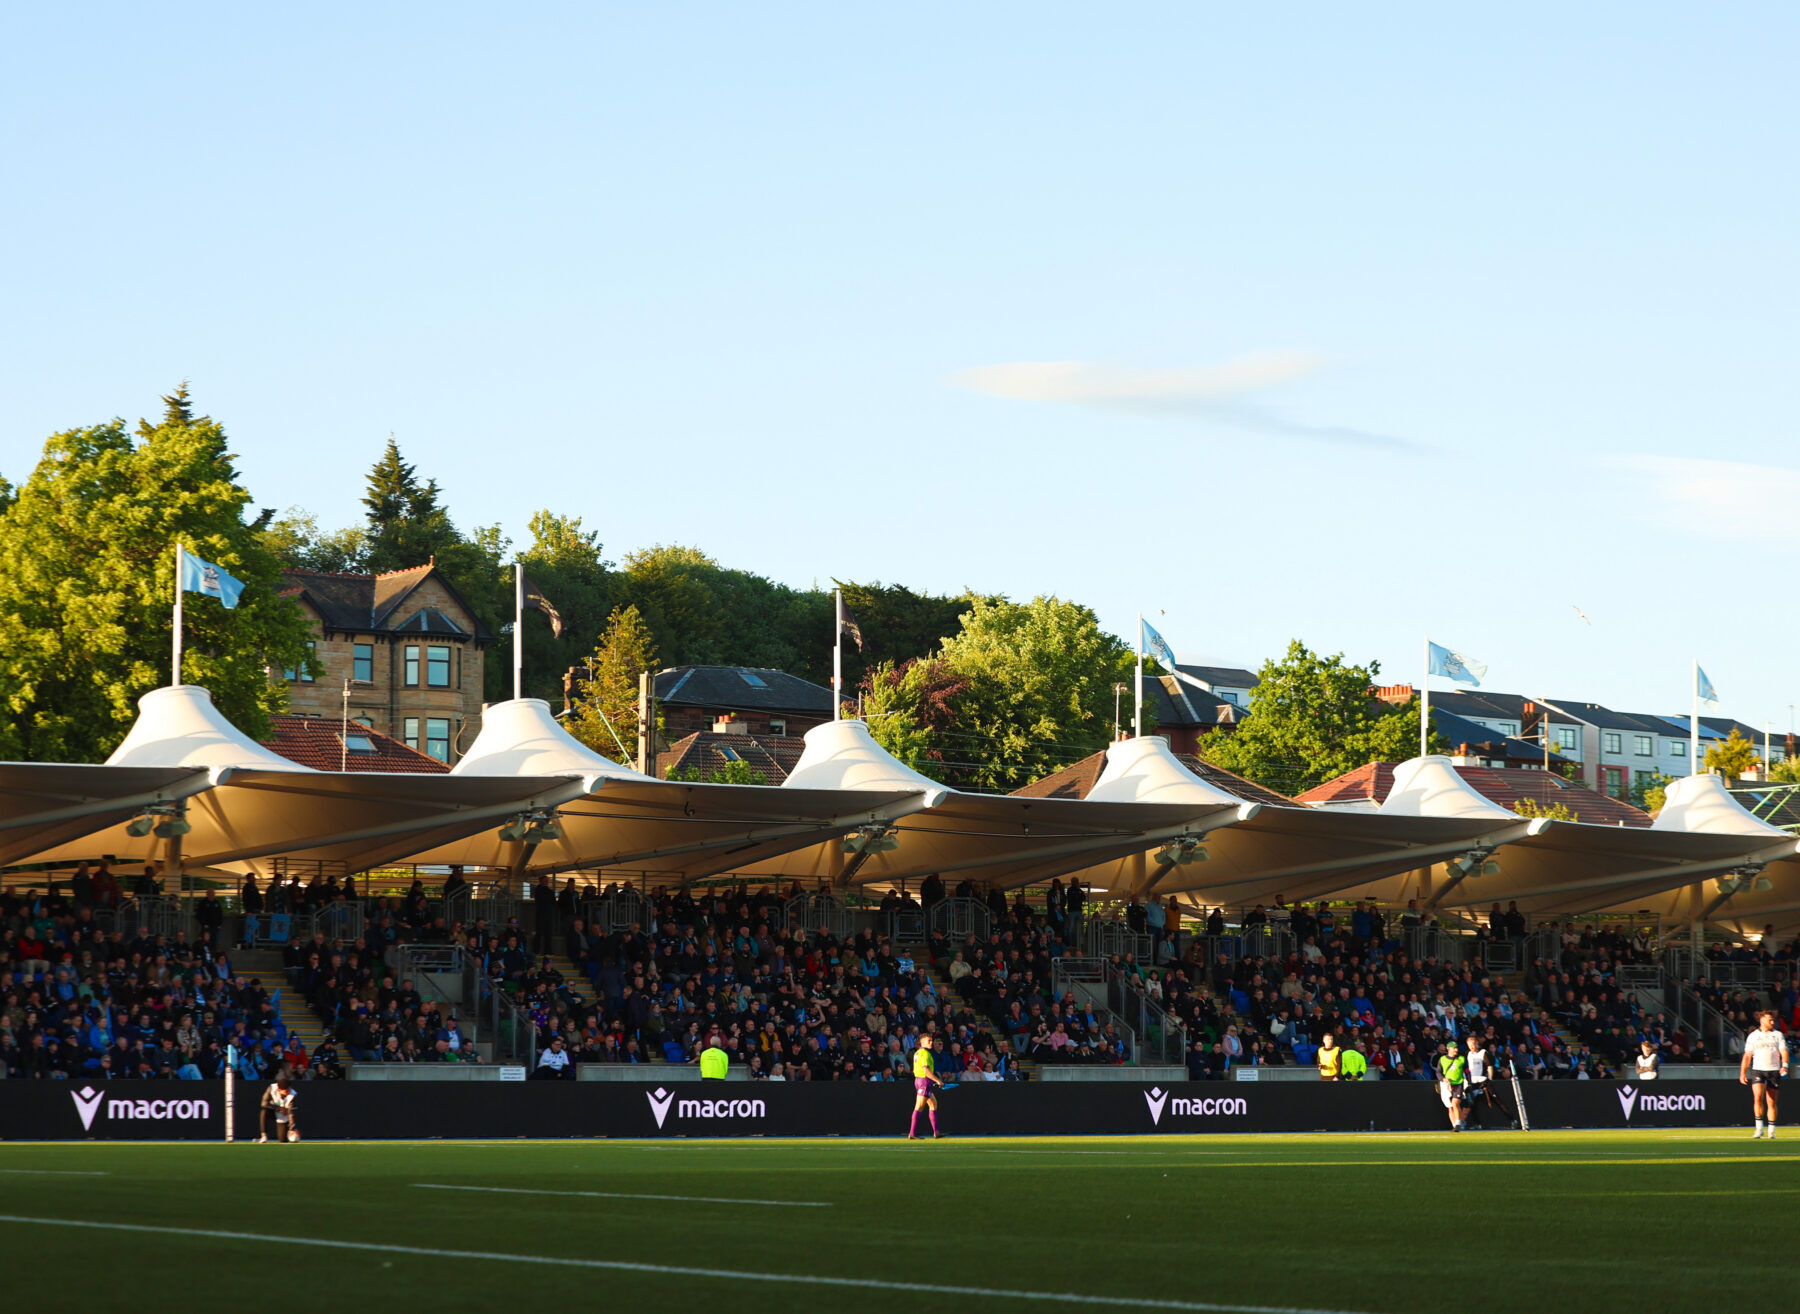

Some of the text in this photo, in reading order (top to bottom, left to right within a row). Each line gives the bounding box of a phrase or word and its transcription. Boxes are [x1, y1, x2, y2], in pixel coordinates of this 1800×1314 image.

[108, 1099, 209, 1119] macron
[679, 1100, 765, 1118] macron
[1172, 1098, 1246, 1115] macron
[1641, 1095, 1705, 1111] macron
